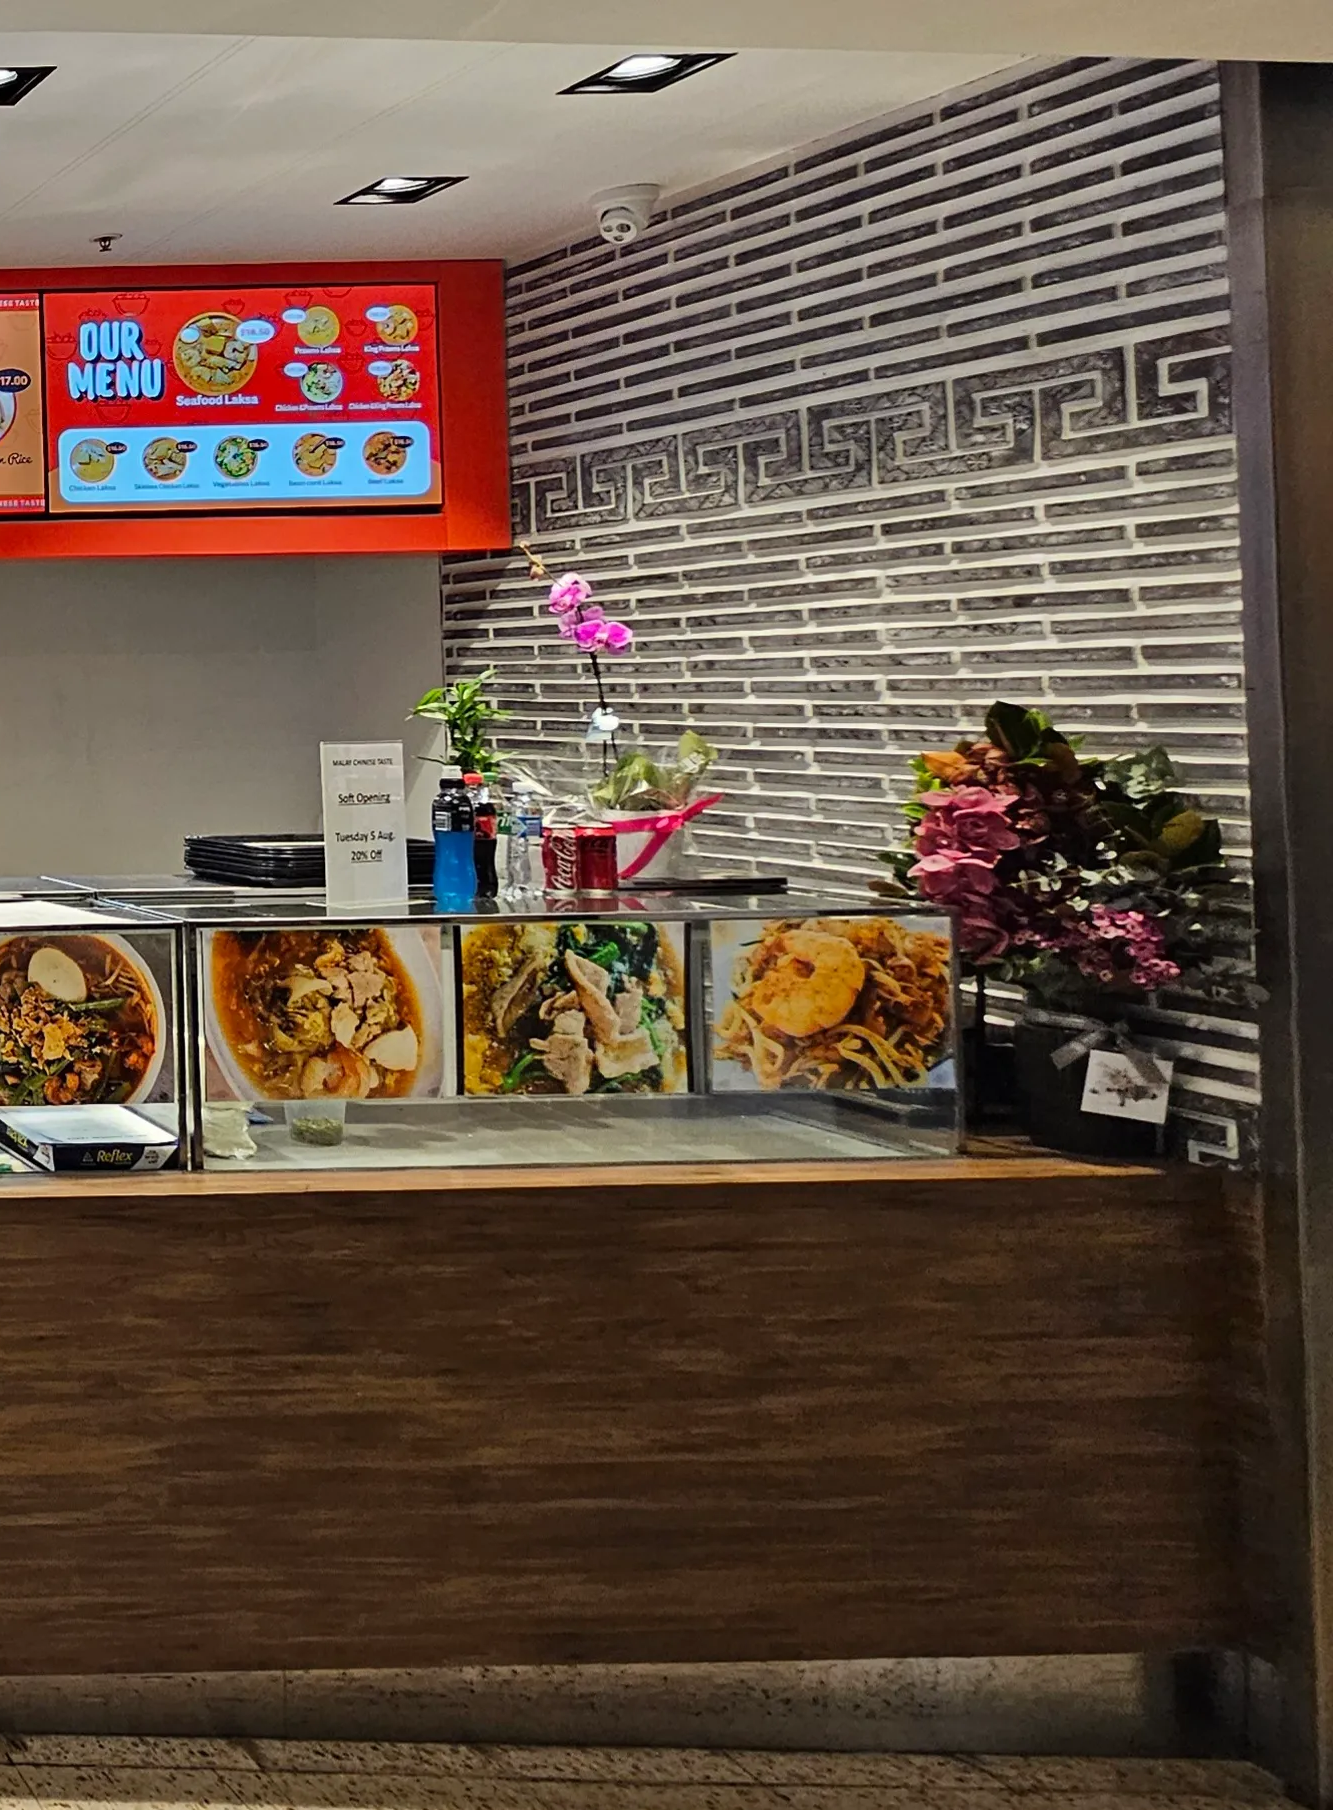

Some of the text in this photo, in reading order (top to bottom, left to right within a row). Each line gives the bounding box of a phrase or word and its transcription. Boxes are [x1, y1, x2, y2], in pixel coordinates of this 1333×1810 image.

[15, 299, 39, 307] TASTE
[79, 320, 145, 361] OUR
[67, 358, 164, 401] MENU
[176, 394, 258, 407] Seafood Laksa
[7, 453, 33, 465] Rice
[20, 499, 45, 507] TASTE
[332, 758, 393, 767] MALAY CHINESE TASTE
[338, 792, 391, 804] Soft Opening
[335, 832, 368, 843] Tuesday
[370, 831, 376, 841] 5
[351, 850, 383, 861] 20% Off
[96, 1149, 133, 1164] Reflex
